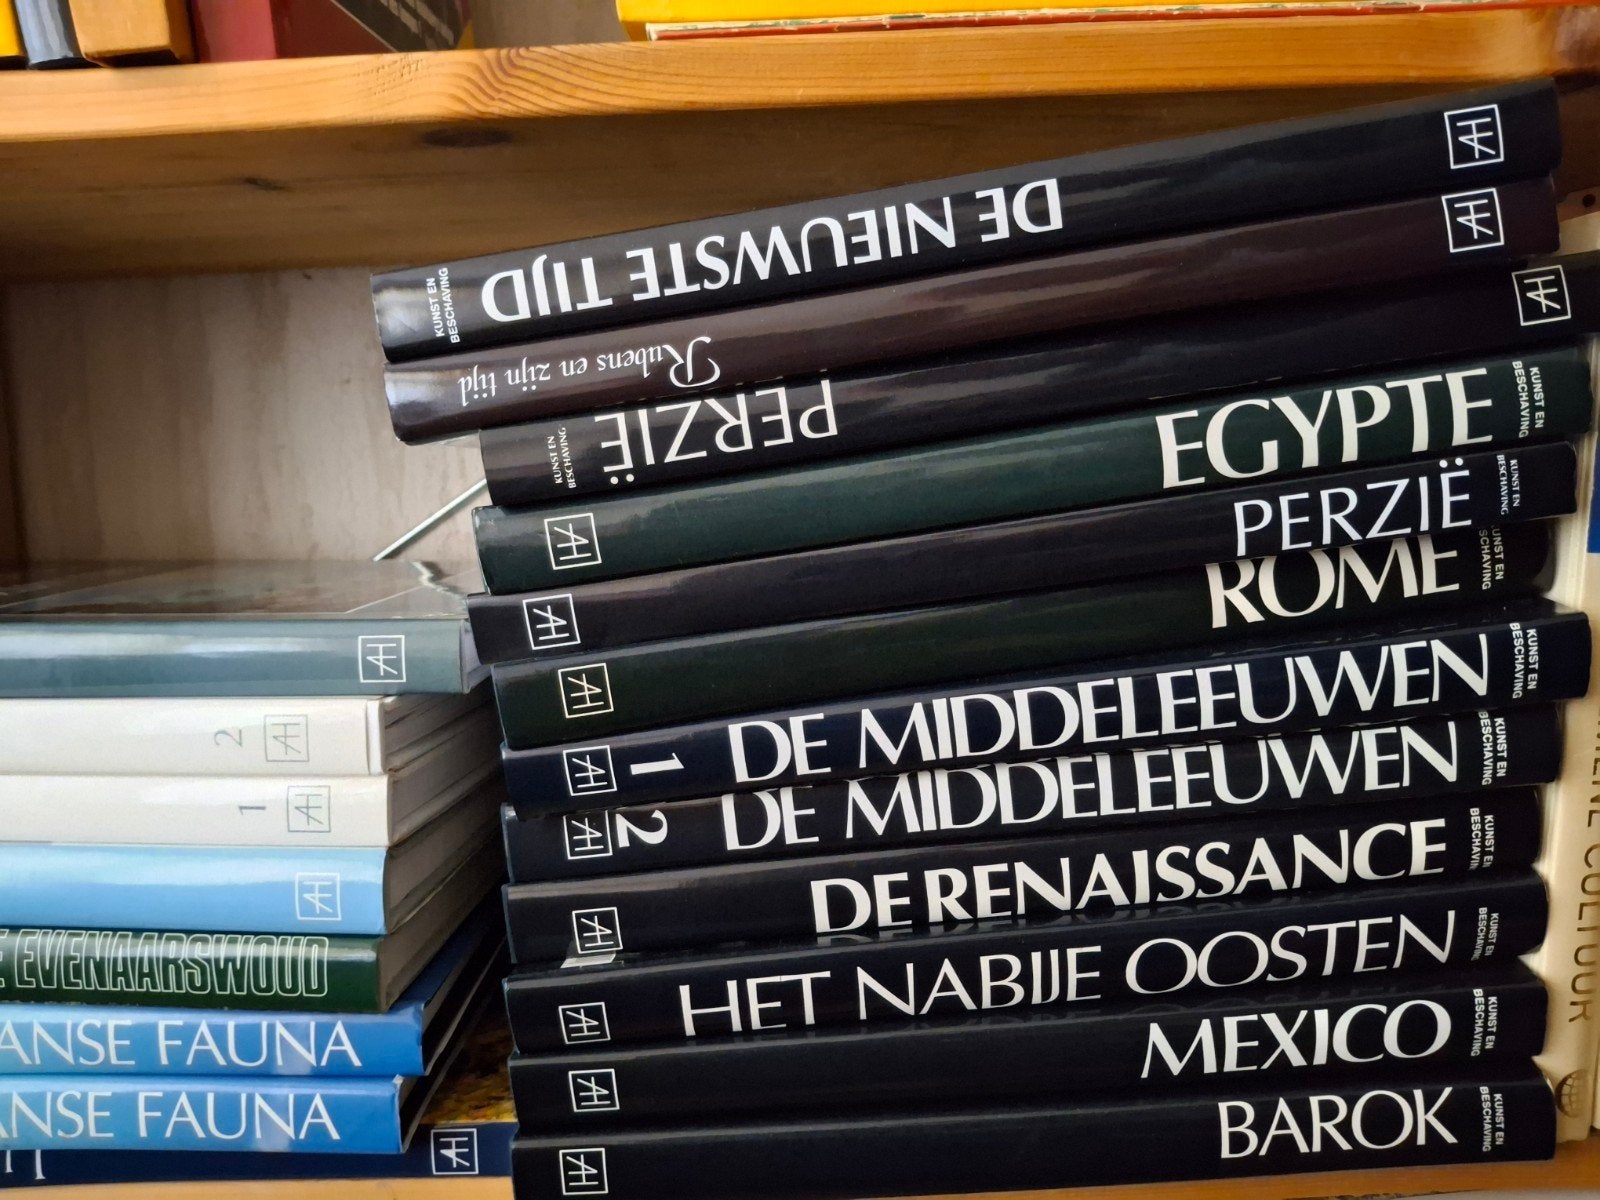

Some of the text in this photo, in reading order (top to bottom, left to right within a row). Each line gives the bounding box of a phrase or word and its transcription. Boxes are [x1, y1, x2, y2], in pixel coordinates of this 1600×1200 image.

[481, 178, 1063, 322] DE NIEUWSTE TIJD
[427, 277, 445, 338] KUNST EN
[438, 267, 461, 344] BESCHAVING
[559, 356, 588, 376] en
[598, 336, 720, 388] Rubens
[1512, 360, 1530, 438] BESCHAVING
[1530, 366, 1545, 428] KUNST EN
[558, 427, 577, 488] BESCHAVING
[595, 380, 838, 484] PERZIË
[1155, 368, 1493, 489] EGYPTE
[547, 435, 563, 484] KUNST EN
[1497, 455, 1509, 515] BESCHAVING
[1509, 459, 1520, 507] KUNST EN
[1233, 457, 1472, 556] PERZIË
[1205, 534, 1460, 628] ROME
[1479, 530, 1492, 590] SCHAVING
[1491, 529, 1505, 580] UNST EN
[1509, 622, 1525, 699] BESCHAVING
[1526, 628, 1539, 689] KUNST EN
[214, 729, 243, 747] 2
[728, 713, 831, 783] DE
[859, 633, 1488, 768] MIDDELEEUWEN
[630, 753, 684, 775] 1
[1478, 710, 1494, 786] BESCHAVING
[1494, 717, 1507, 777] KUNST EN
[721, 721, 1457, 851] DE MIDDELEEUWEN
[616, 809, 668, 848] 2
[1484, 814, 1494, 852] KUNST
[810, 818, 1447, 933] DE RENAISSANCE
[1488, 912, 1499, 944] KUNST
[15, 929, 329, 997] EVENAARSWOUD
[679, 910, 1456, 1036] HET NABIJE OOSTEN
[158, 1020, 362, 1067] FAUNA
[1141, 1000, 1451, 1078] MEXICO
[1470, 988, 1485, 1057] BESCHAVING
[1484, 996, 1498, 1050] KUNST EN
[0, 1090, 341, 1140] NSE FAUNA
[1218, 1086, 1458, 1158] BAROK
[1479, 1086, 1492, 1152] BESCHAVING
[1493, 1093, 1505, 1145] KUNST EN
